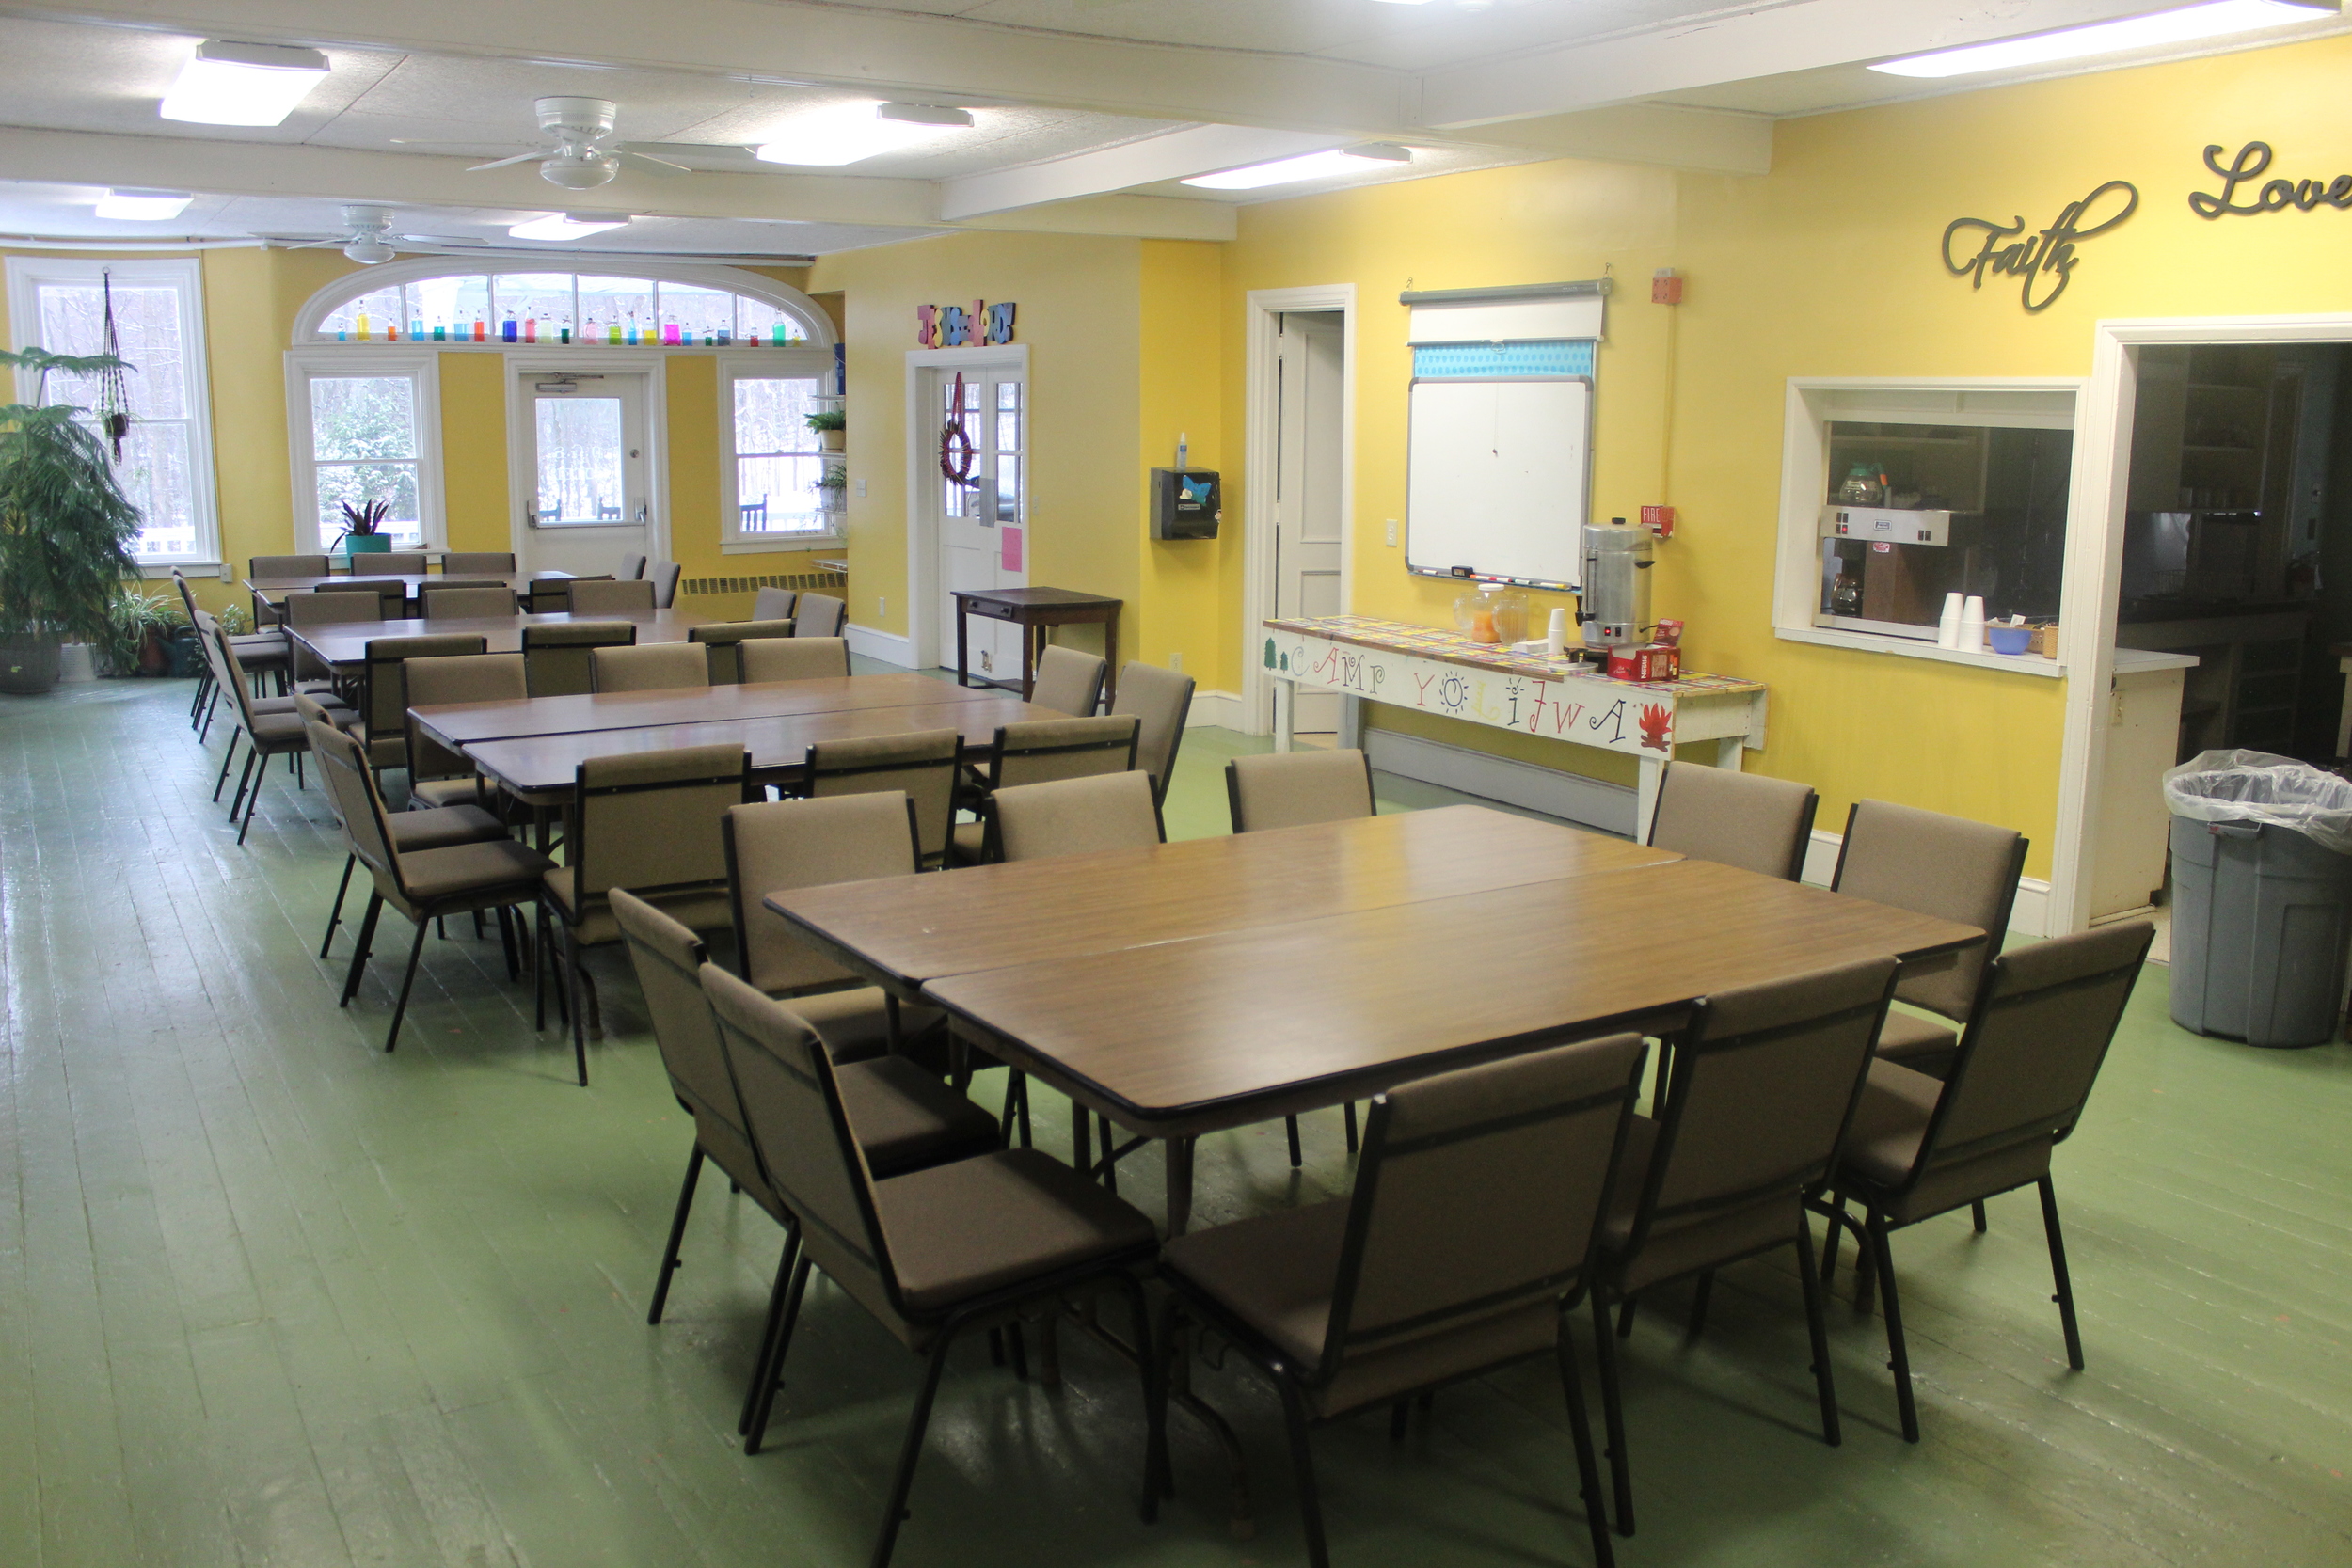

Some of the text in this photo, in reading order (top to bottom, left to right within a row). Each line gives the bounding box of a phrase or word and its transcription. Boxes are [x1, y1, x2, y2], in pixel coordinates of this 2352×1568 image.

[2188, 140, 2352, 219] Love
[1941, 180, 2139, 313] Faith
[1643, 507, 1661, 522] FIRE
[1291, 645, 1386, 695] CAMP
